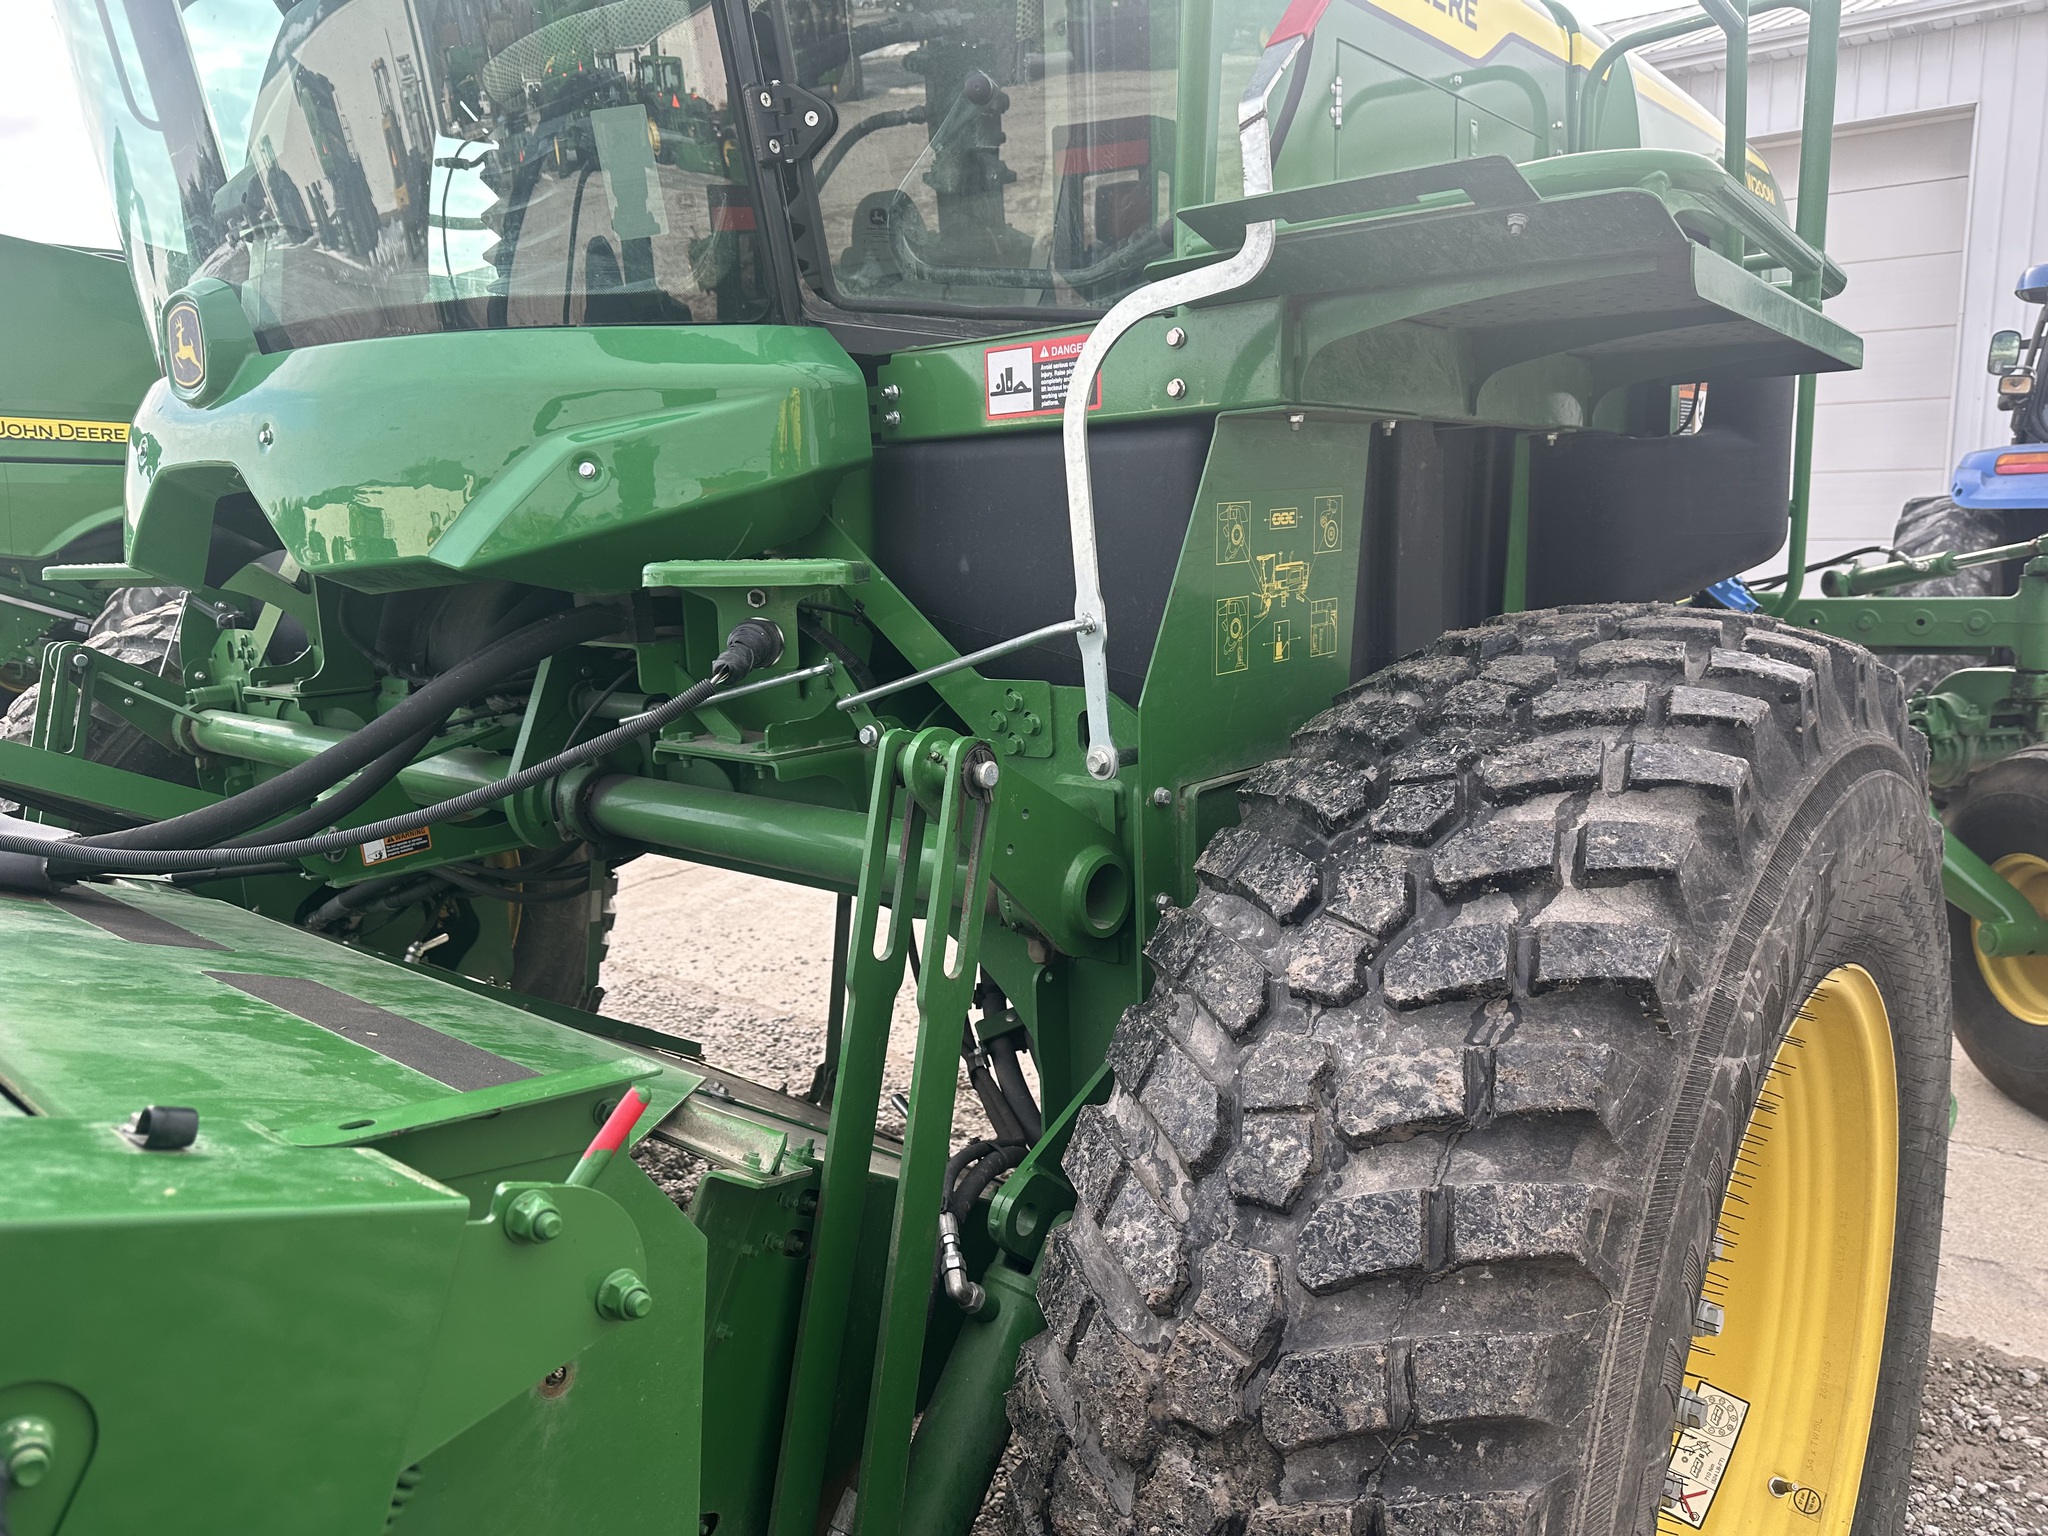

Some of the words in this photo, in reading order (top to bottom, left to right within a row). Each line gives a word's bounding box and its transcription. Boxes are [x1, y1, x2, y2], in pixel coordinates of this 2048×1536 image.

[0, 421, 53, 437] JOHN
[58, 423, 126, 440] DEERE
[394, 827, 426, 841] WARNING
